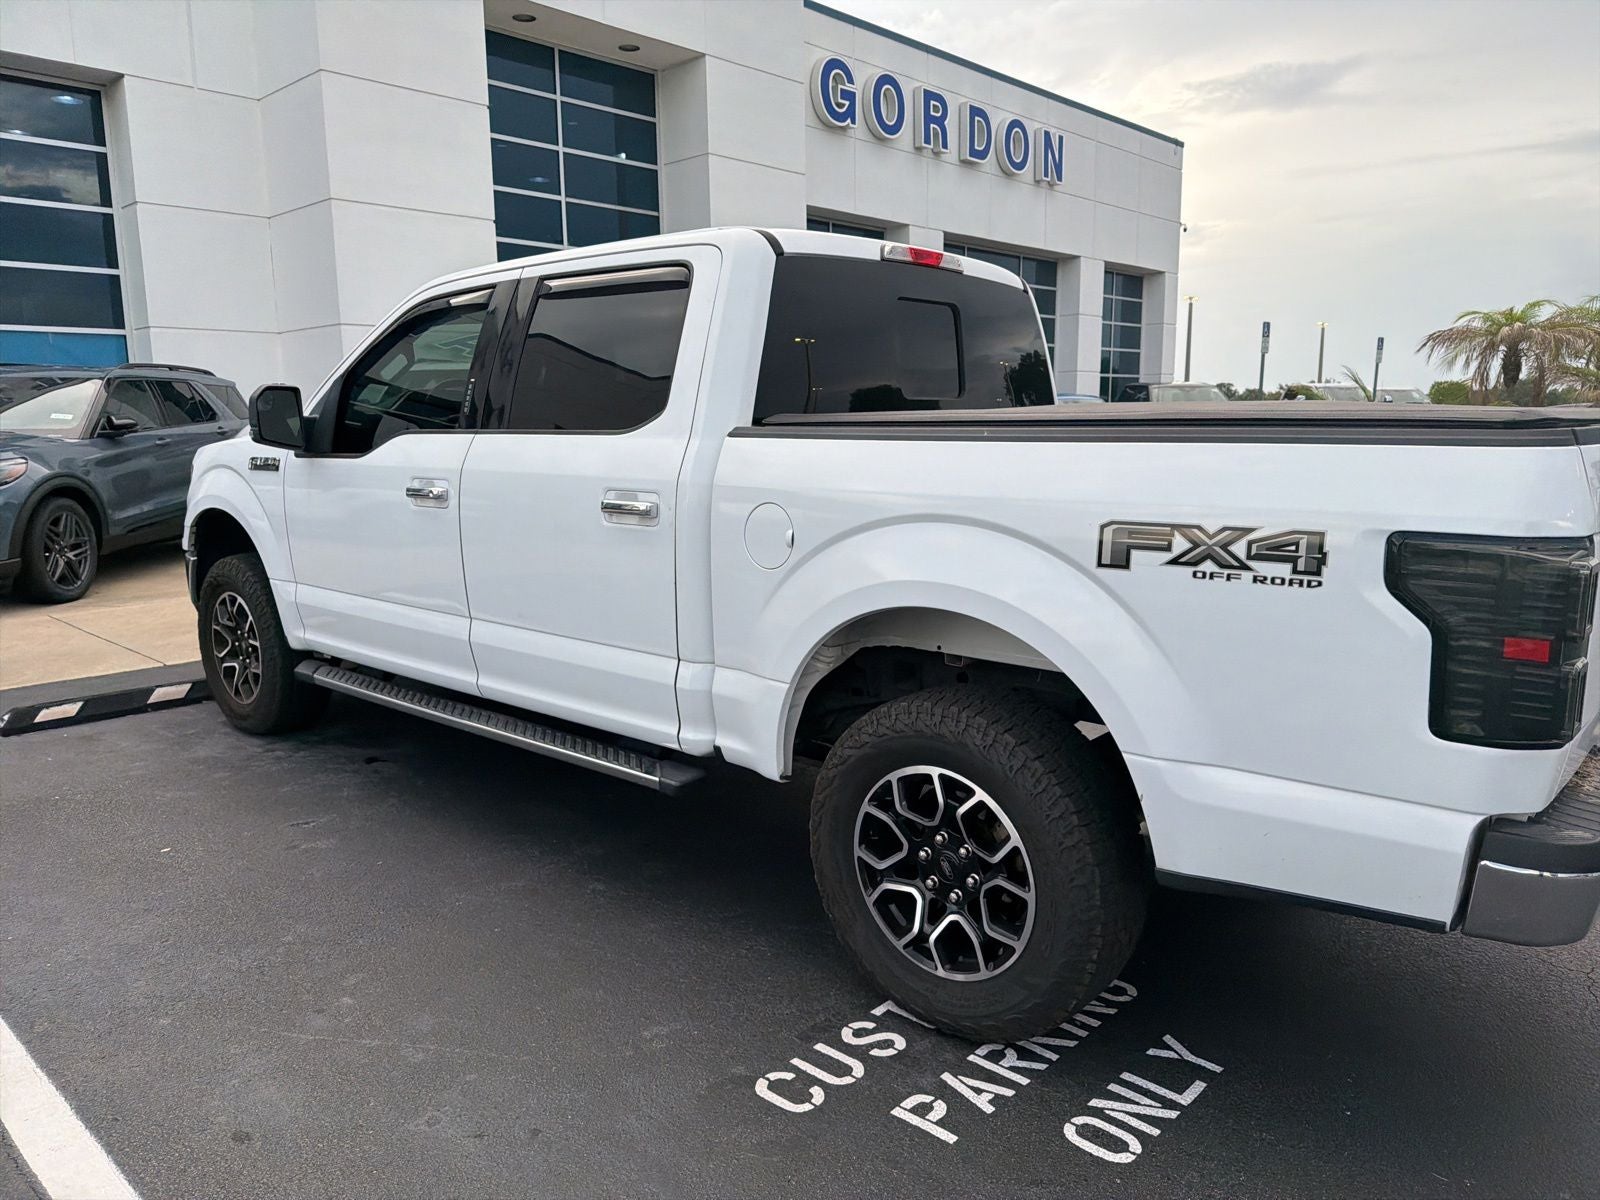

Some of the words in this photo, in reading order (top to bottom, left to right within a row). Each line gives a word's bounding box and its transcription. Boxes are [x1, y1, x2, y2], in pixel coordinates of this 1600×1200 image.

[811, 56, 1065, 186] GORDON
[1097, 520, 1328, 577] FX4
[1192, 570, 1242, 582] OFF
[1252, 575, 1323, 588] ROAD
[1063, 1034, 1224, 1164] ONLY
